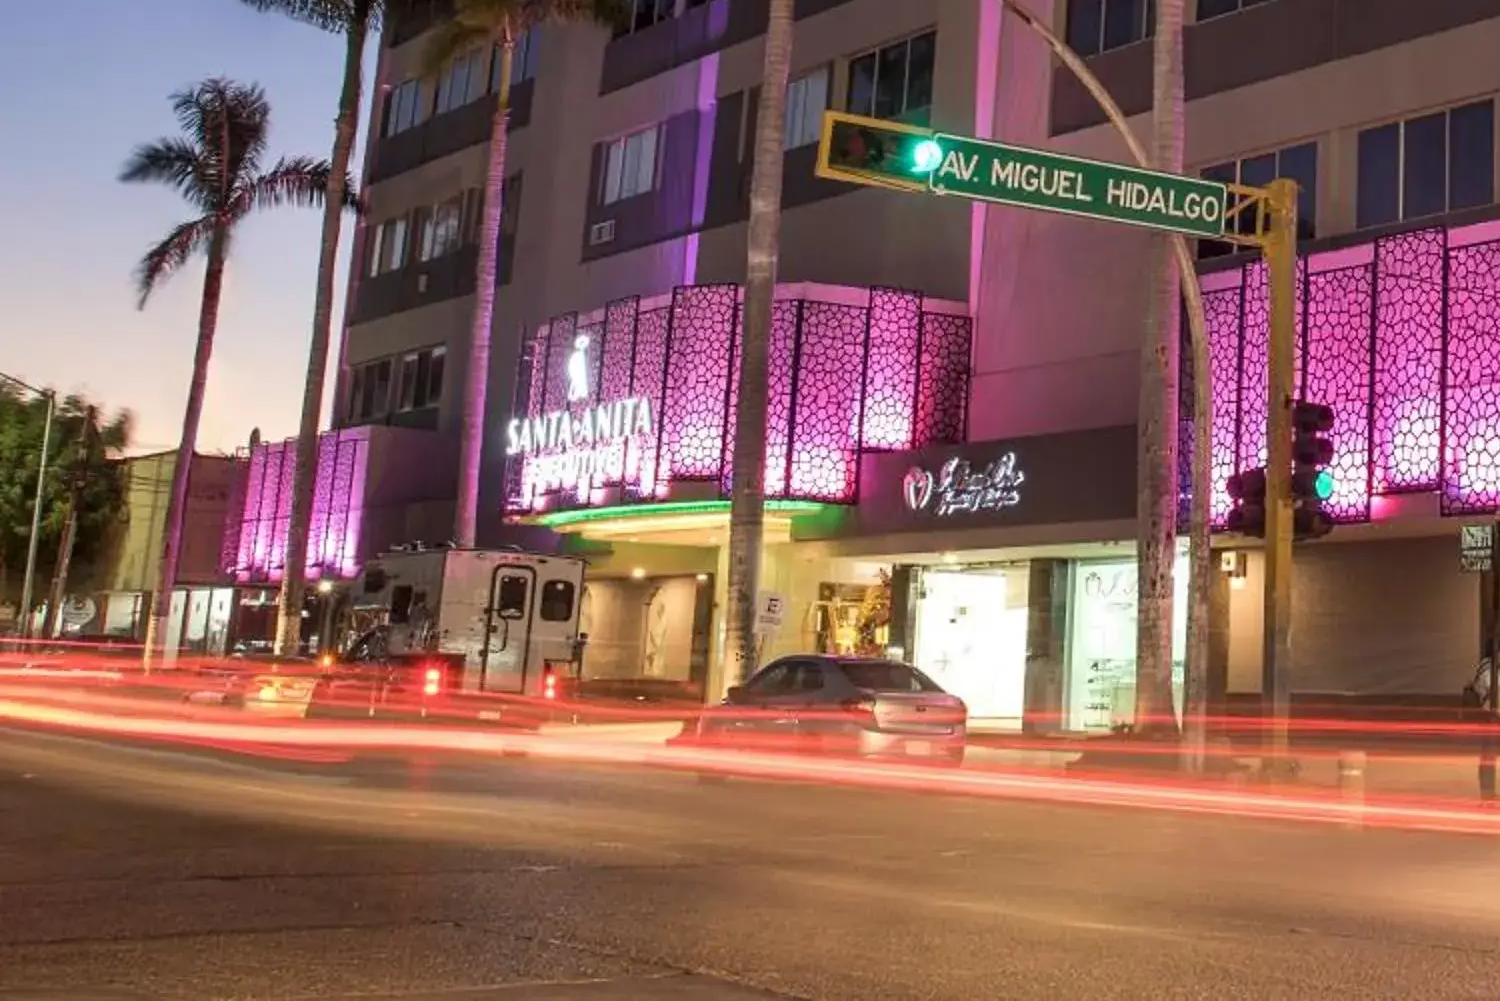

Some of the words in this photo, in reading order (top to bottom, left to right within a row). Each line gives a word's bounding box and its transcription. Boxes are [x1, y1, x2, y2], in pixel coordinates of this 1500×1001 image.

[938, 149, 981, 183] AV.
[991, 157, 1093, 202] MIGUEL
[1106, 177, 1220, 223] HIDALGO
[506, 410, 573, 455] SANTA
[579, 397, 652, 441] ANITA
